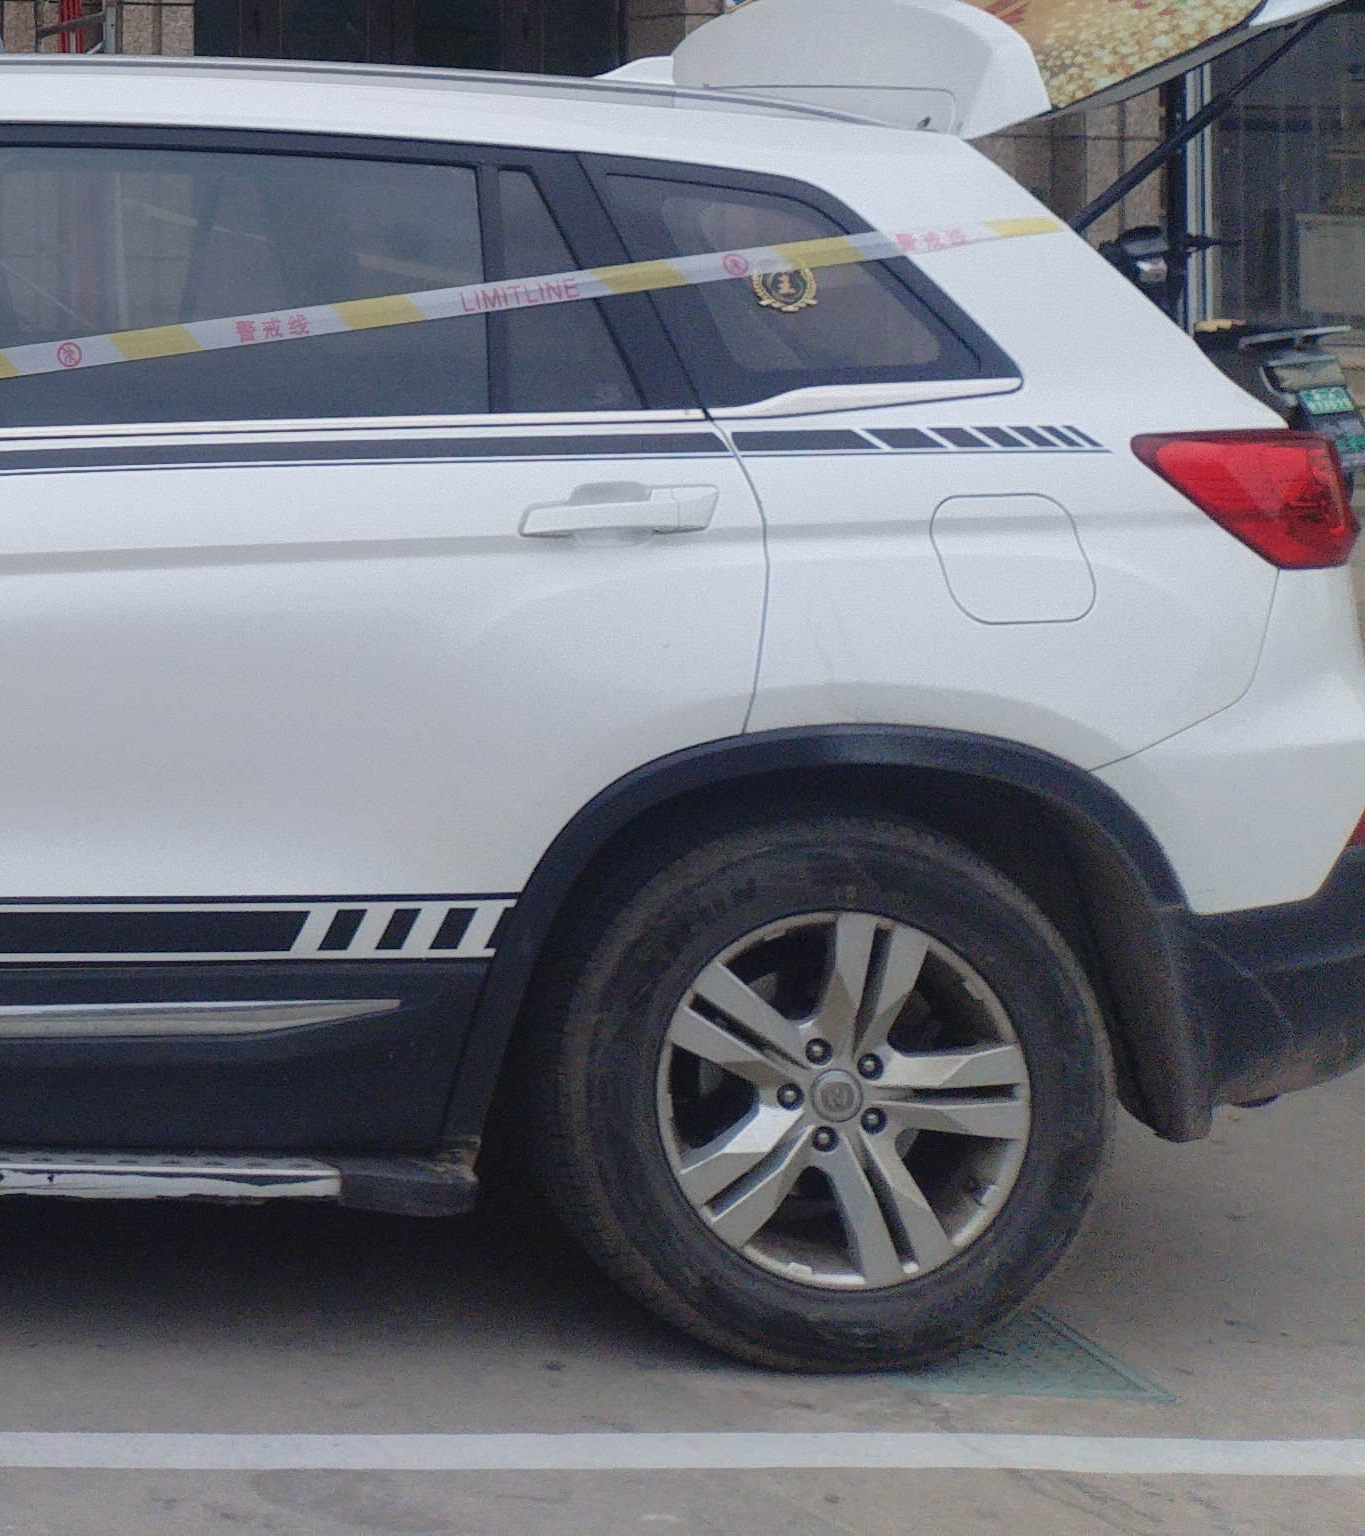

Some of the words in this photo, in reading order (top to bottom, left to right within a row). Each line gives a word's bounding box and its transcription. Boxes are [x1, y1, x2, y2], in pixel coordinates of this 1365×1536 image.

[459, 276, 582, 314] LIMITLINE
[235, 312, 311, 345] 警戒线
